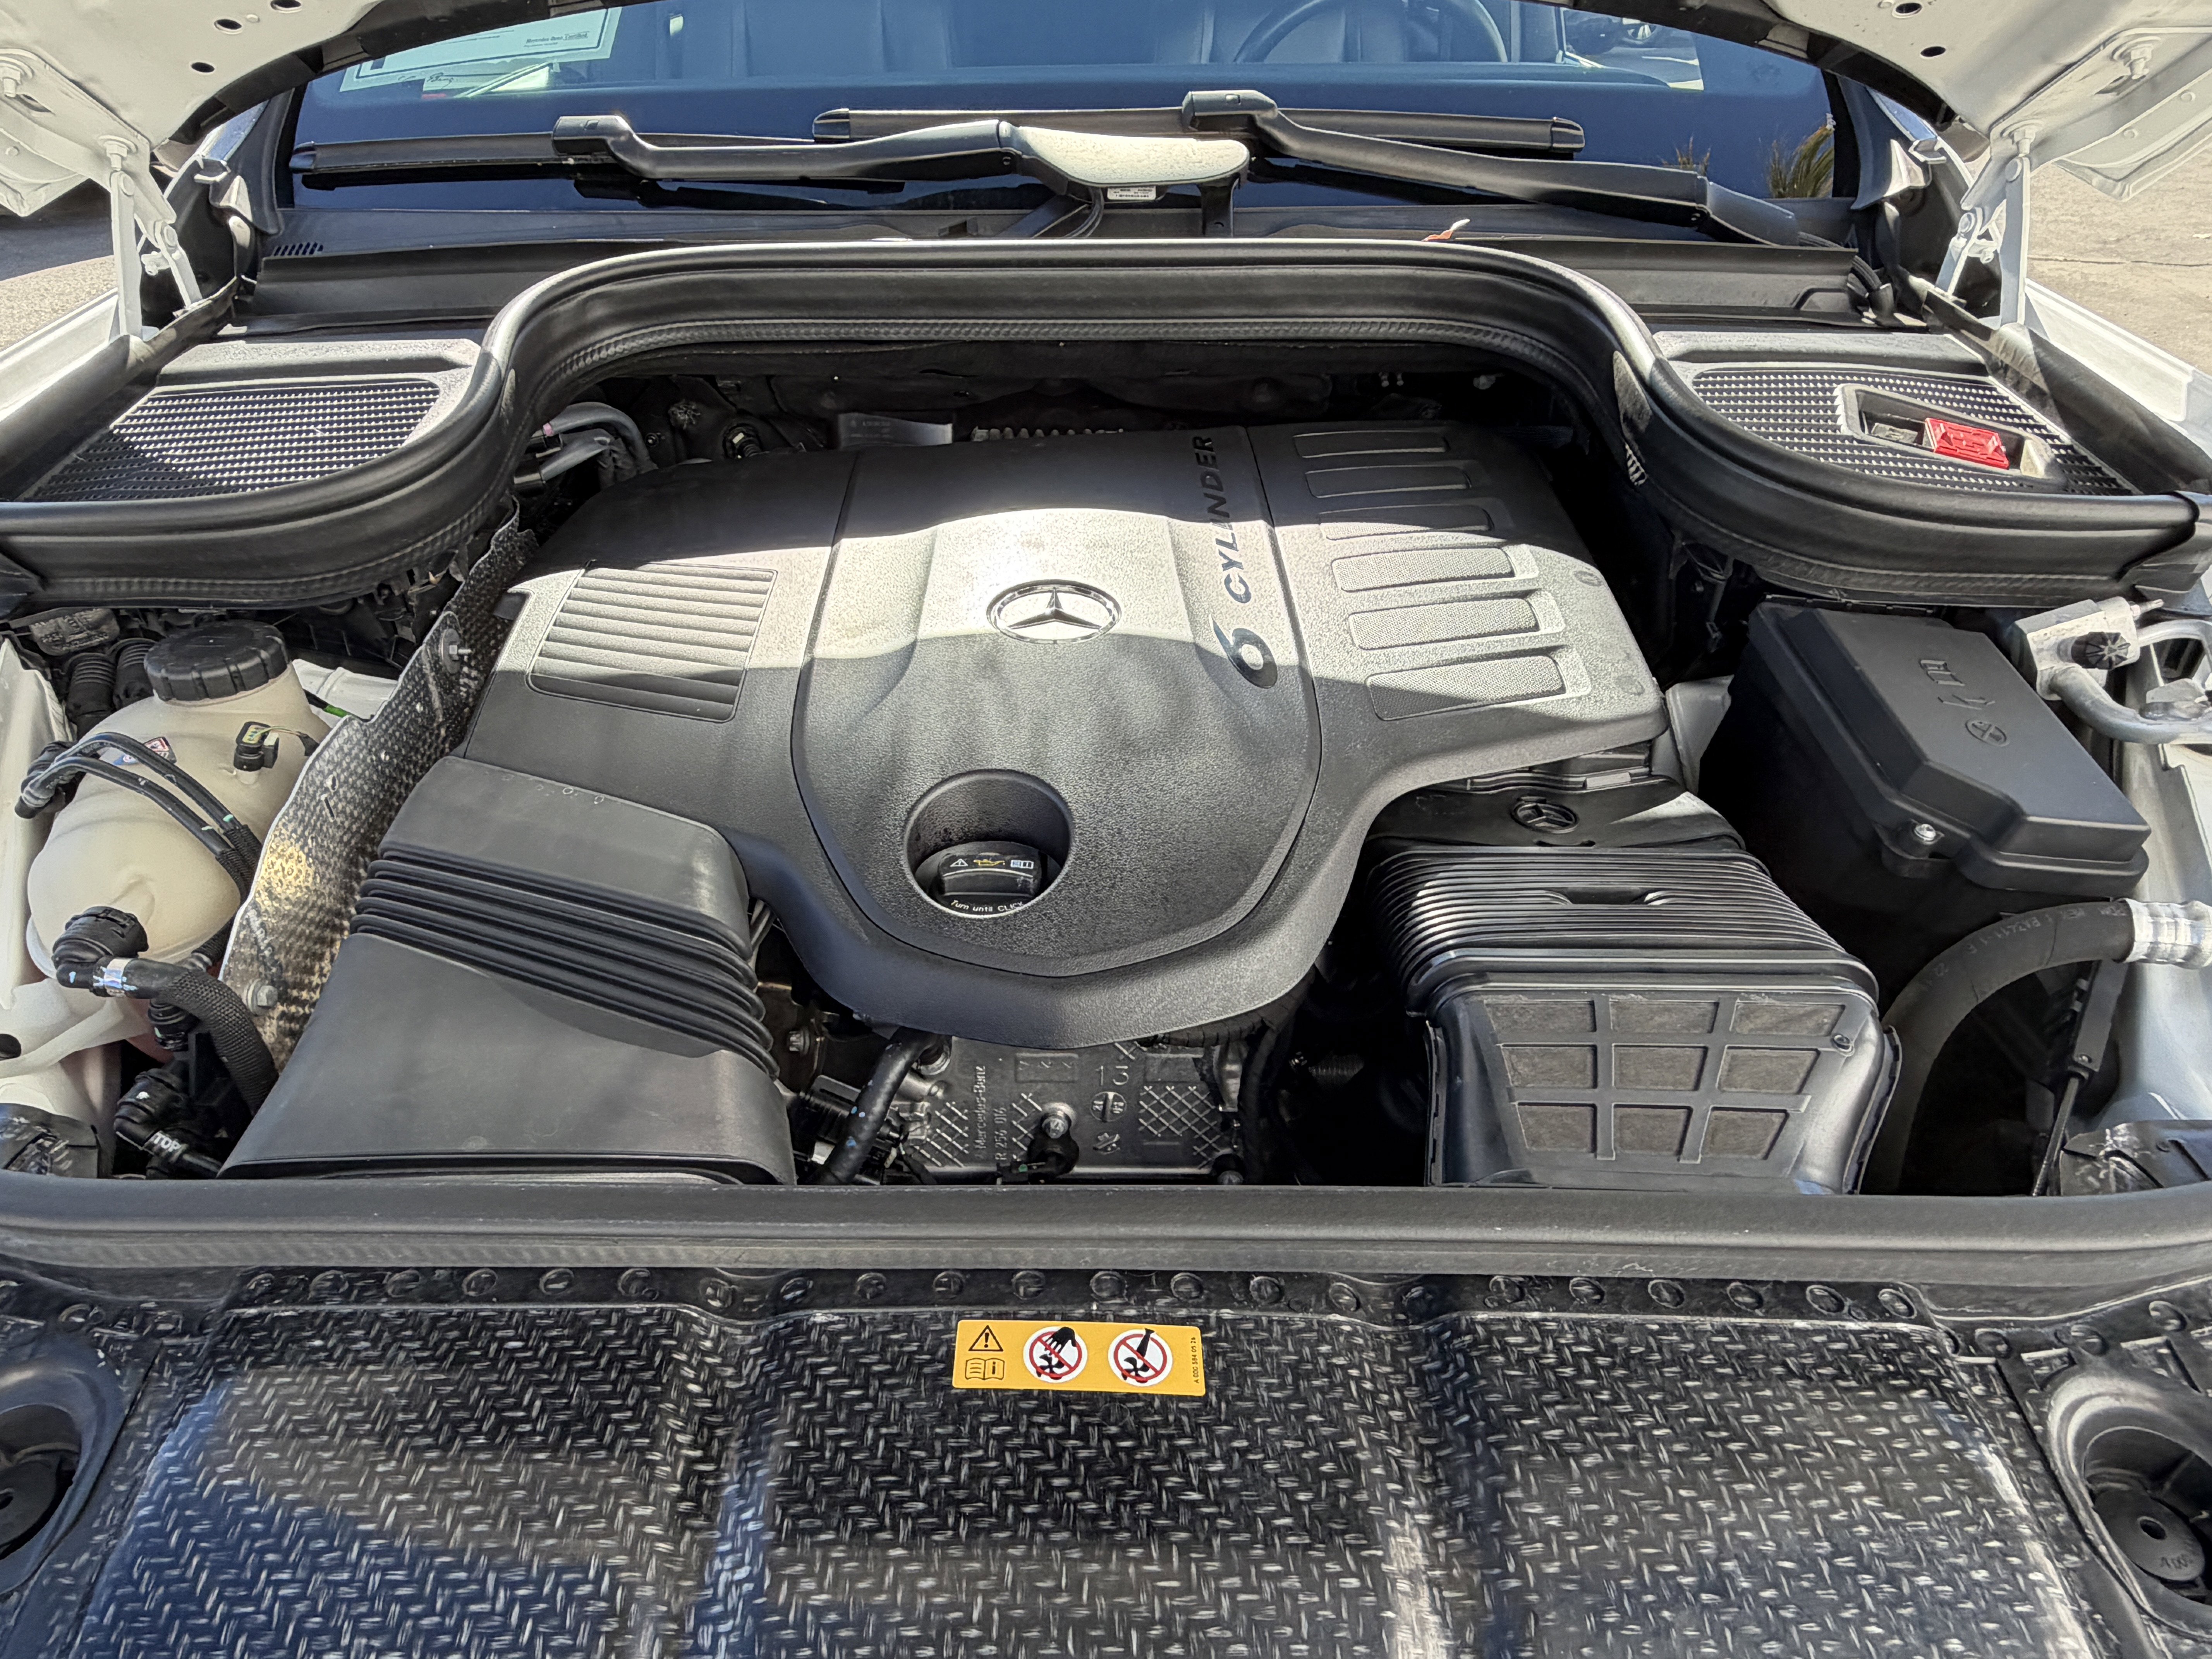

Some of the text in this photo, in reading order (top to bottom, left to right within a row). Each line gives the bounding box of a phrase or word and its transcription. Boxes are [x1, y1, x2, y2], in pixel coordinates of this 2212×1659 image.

[1193, 435, 1278, 689] 6 CYLINDER
[951, 900, 969, 910] Turn
[998, 901, 1023, 912] CLICK
[153, 1131, 182, 1152] TOP
